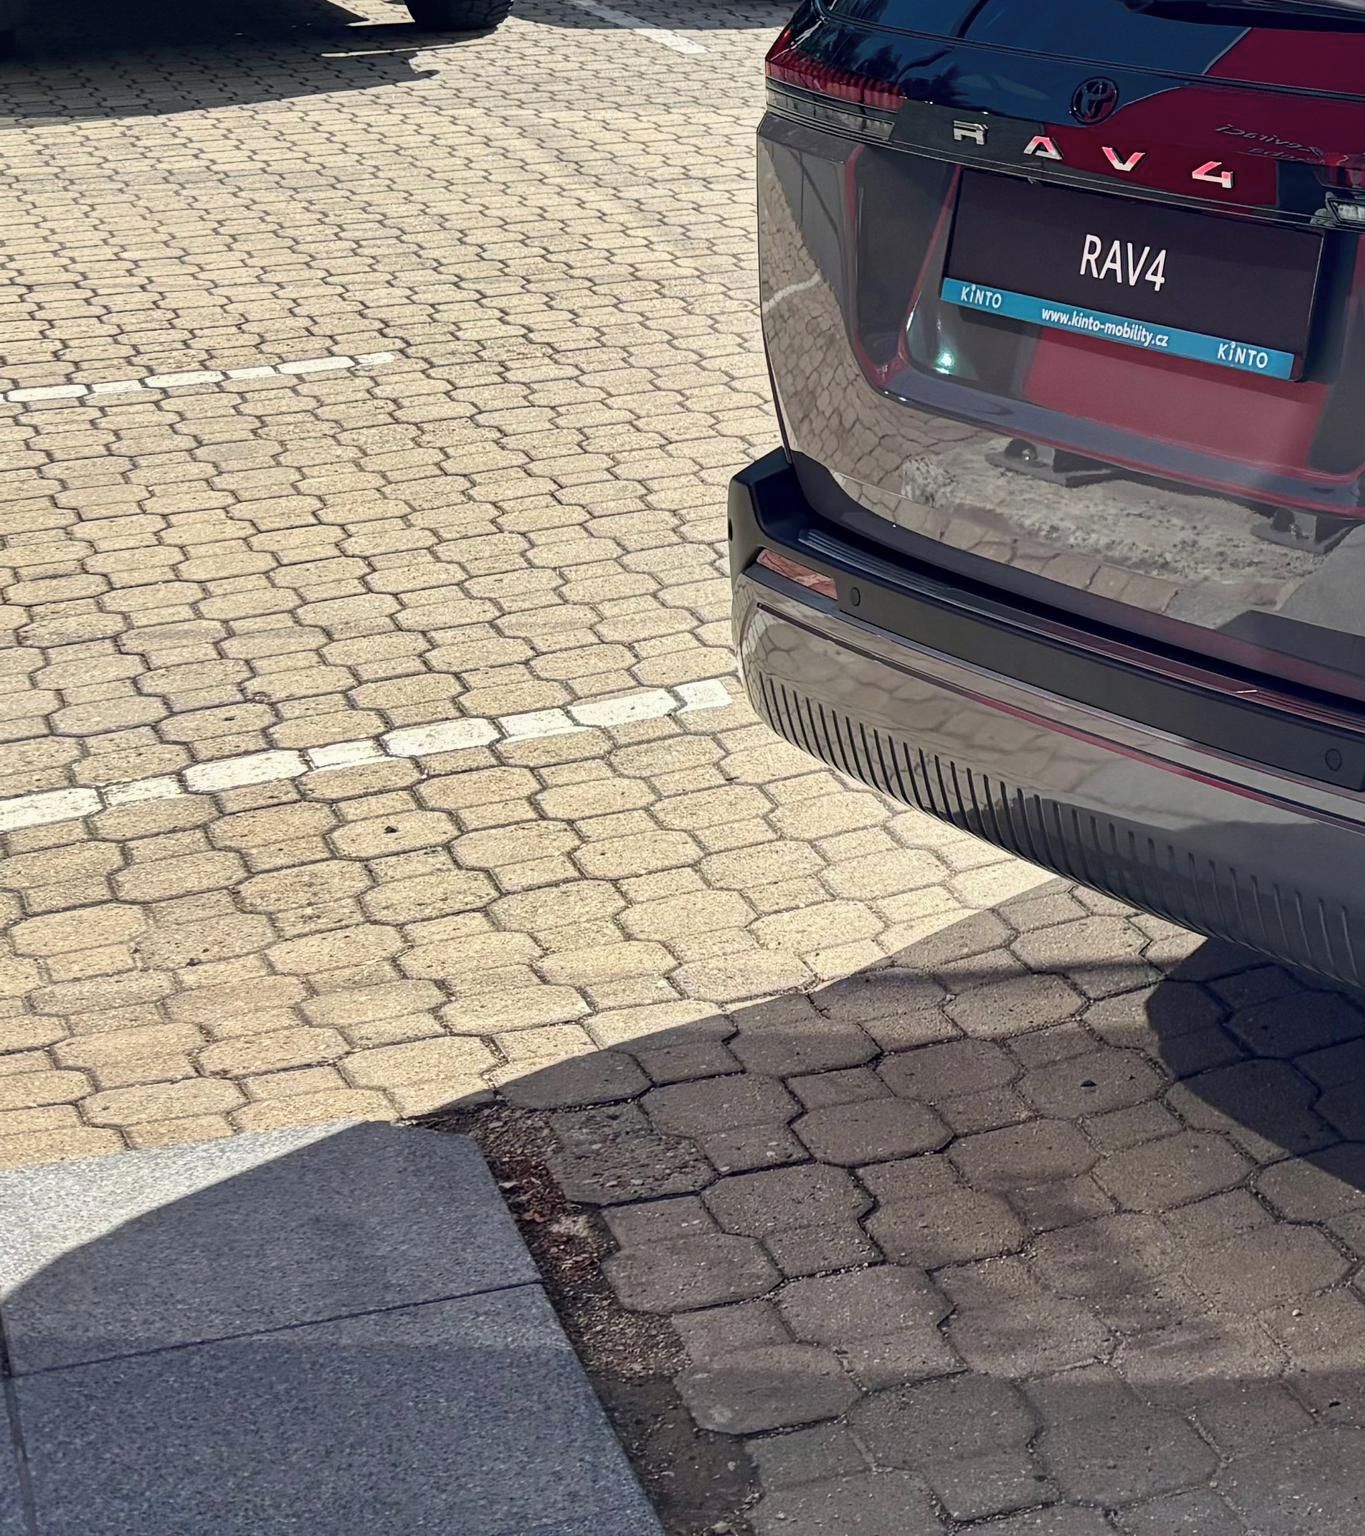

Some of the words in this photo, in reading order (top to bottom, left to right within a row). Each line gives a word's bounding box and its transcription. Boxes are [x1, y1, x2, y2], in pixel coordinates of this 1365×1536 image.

[953, 120, 1234, 190] RAV4
[1080, 233, 1167, 293] RAV4
[1041, 307, 1169, 348] www.kinto-mobility.cz
